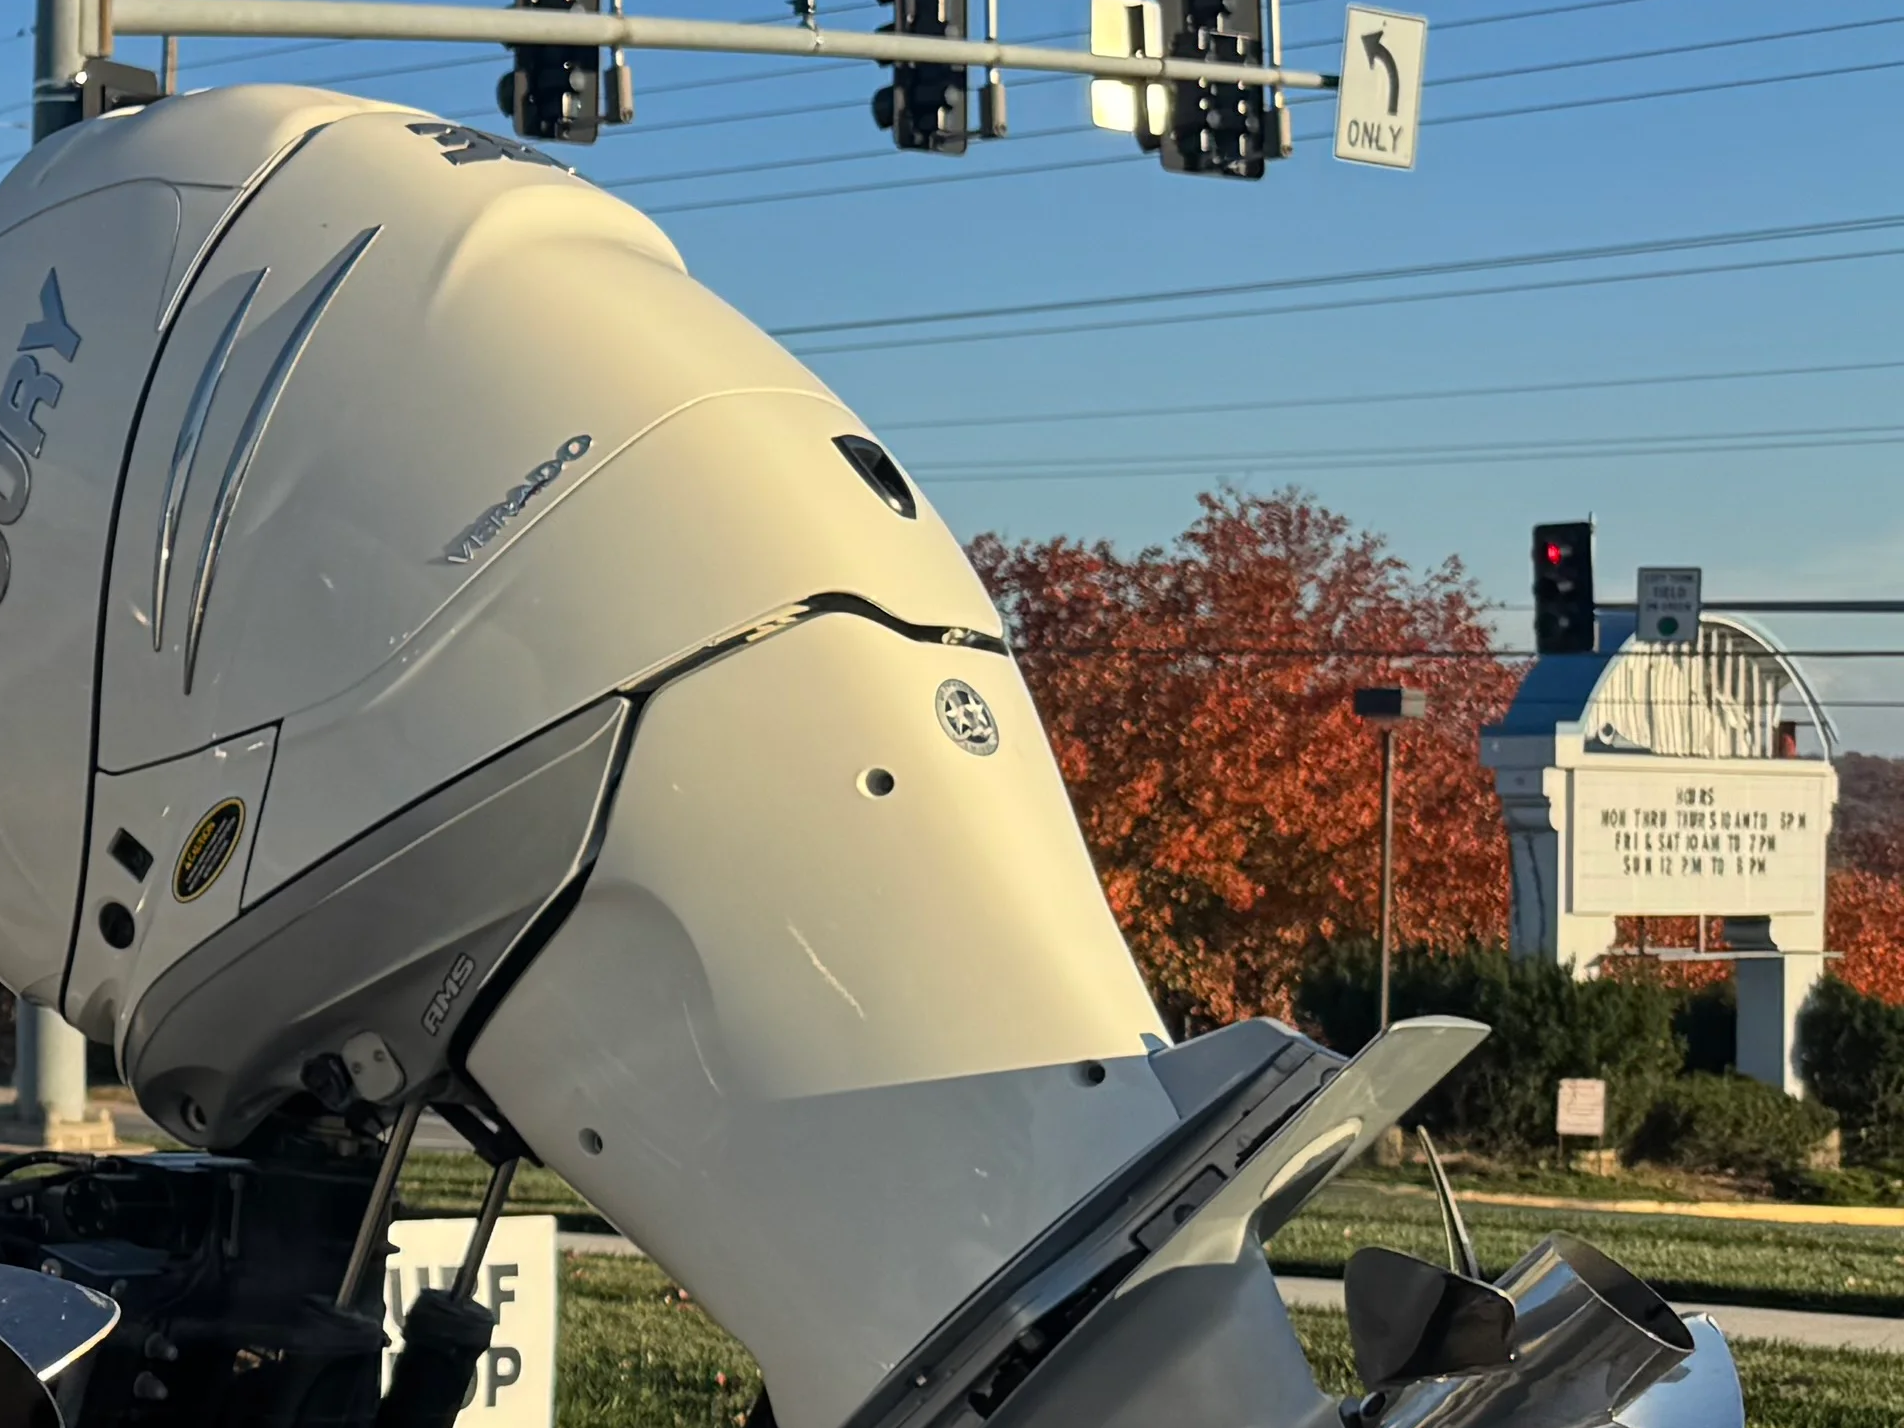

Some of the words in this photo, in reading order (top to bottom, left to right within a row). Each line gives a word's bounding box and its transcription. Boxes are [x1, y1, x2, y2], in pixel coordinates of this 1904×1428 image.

[1347, 117, 1404, 153] ONLY
[446, 434, 593, 563] VERADO
[1676, 787, 1714, 806] HOURS
[1601, 809, 1626, 828] MON
[1634, 808, 1667, 829] THRU
[1676, 810, 1717, 830] THURS
[1615, 831, 1638, 851] FRI
[1658, 832, 1680, 852] SAT
[1727, 834, 1741, 852] TO
[1623, 855, 1652, 875] SUN
[1661, 856, 1672, 876] 12
[1681, 856, 1702, 875] PM
[1712, 857, 1725, 876] TO
[420, 952, 477, 1037] AMS
